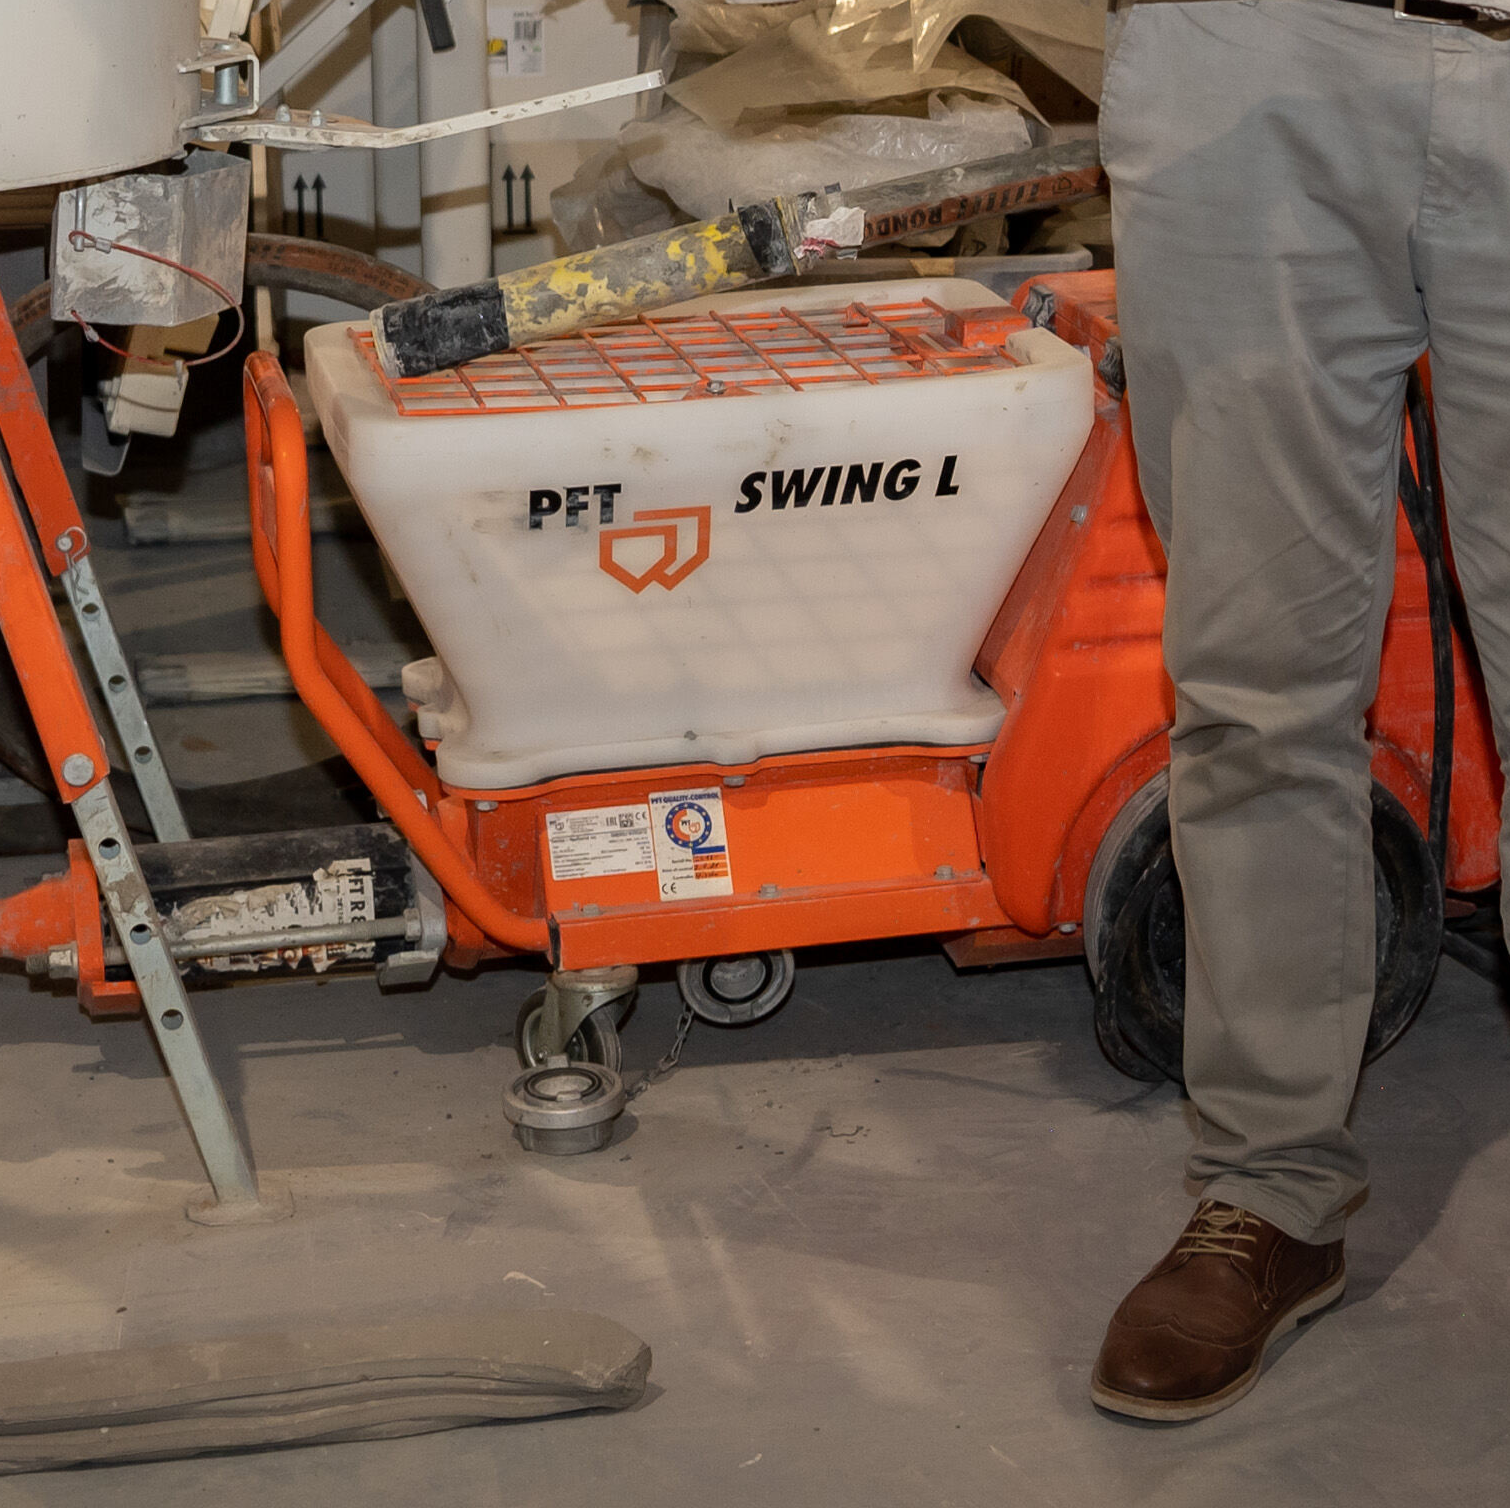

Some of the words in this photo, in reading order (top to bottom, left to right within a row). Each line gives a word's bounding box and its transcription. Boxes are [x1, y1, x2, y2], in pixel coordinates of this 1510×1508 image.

[528, 483, 623, 531] PFT
[734, 457, 922, 515] SWING
[934, 454, 961, 498] L
